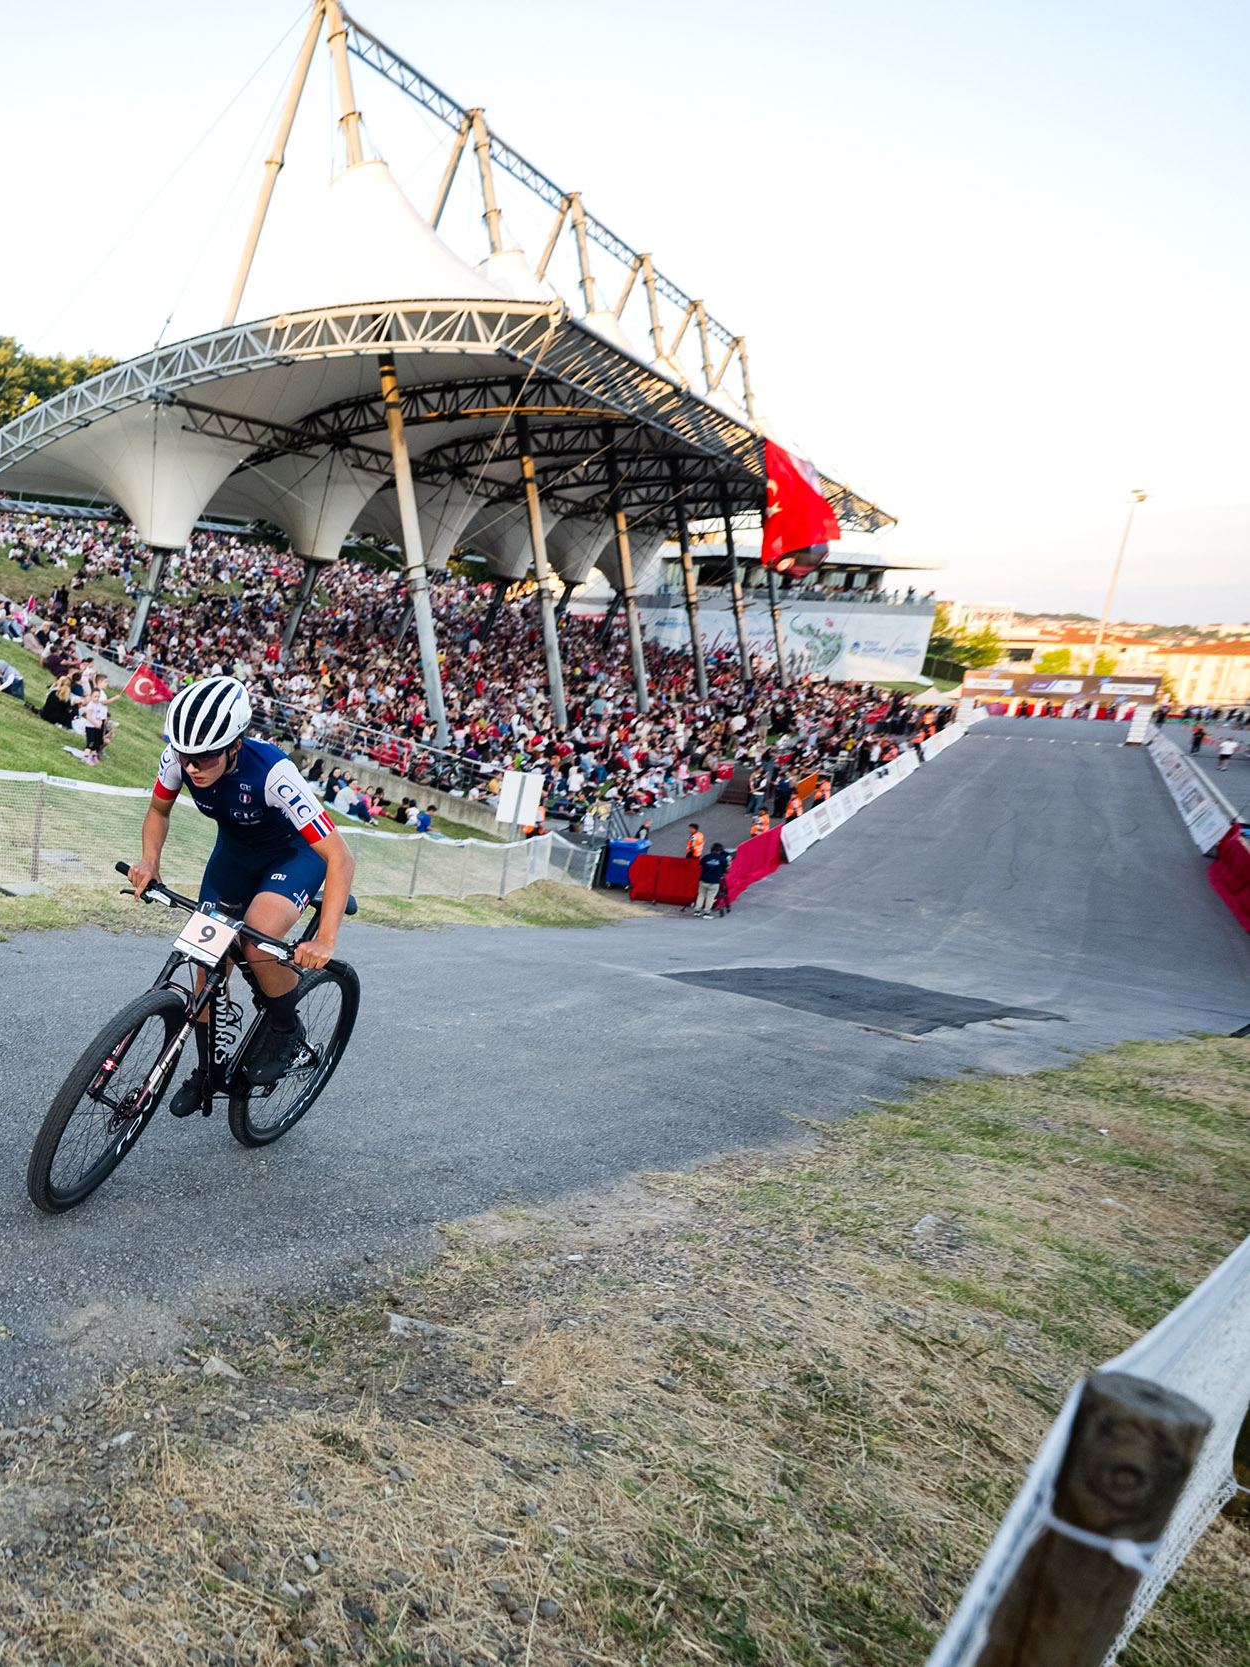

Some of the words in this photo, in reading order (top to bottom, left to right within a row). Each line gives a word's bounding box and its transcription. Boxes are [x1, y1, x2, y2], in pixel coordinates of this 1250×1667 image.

[277, 784, 312, 819] CIC
[233, 811, 260, 819] CIC
[198, 925, 217, 943] 9
